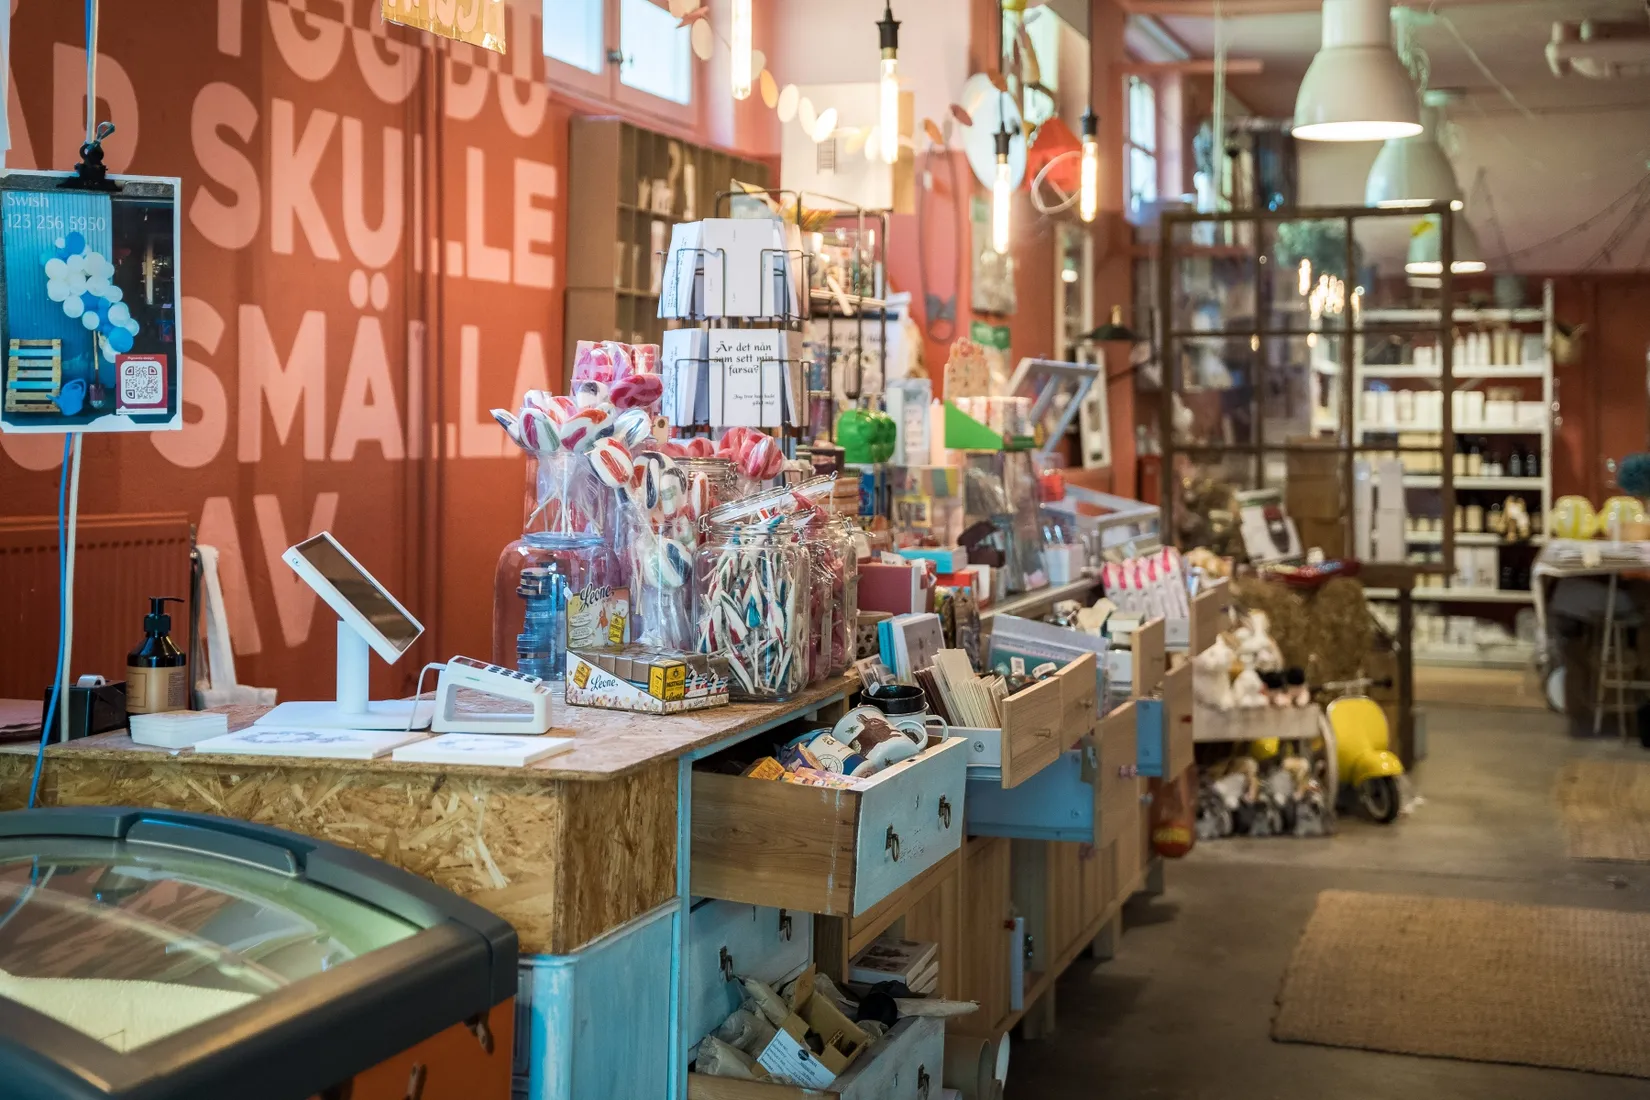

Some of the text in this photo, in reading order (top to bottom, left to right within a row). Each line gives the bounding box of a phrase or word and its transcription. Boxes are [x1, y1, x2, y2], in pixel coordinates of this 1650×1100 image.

[189, 82, 557, 289] SKULLE
[6, 192, 49, 208] Swish
[6, 214, 106, 231] 123 256 5950
[716, 341, 732, 353] Är
[736, 342, 750, 352] det
[736, 354, 753, 362] sett
[150, 270, 552, 468] SMÄLLA
[728, 365, 760, 376] farsa?
[196, 492, 339, 655] AV
[579, 582, 615, 611] Leone
[590, 675, 619, 691] Leone
